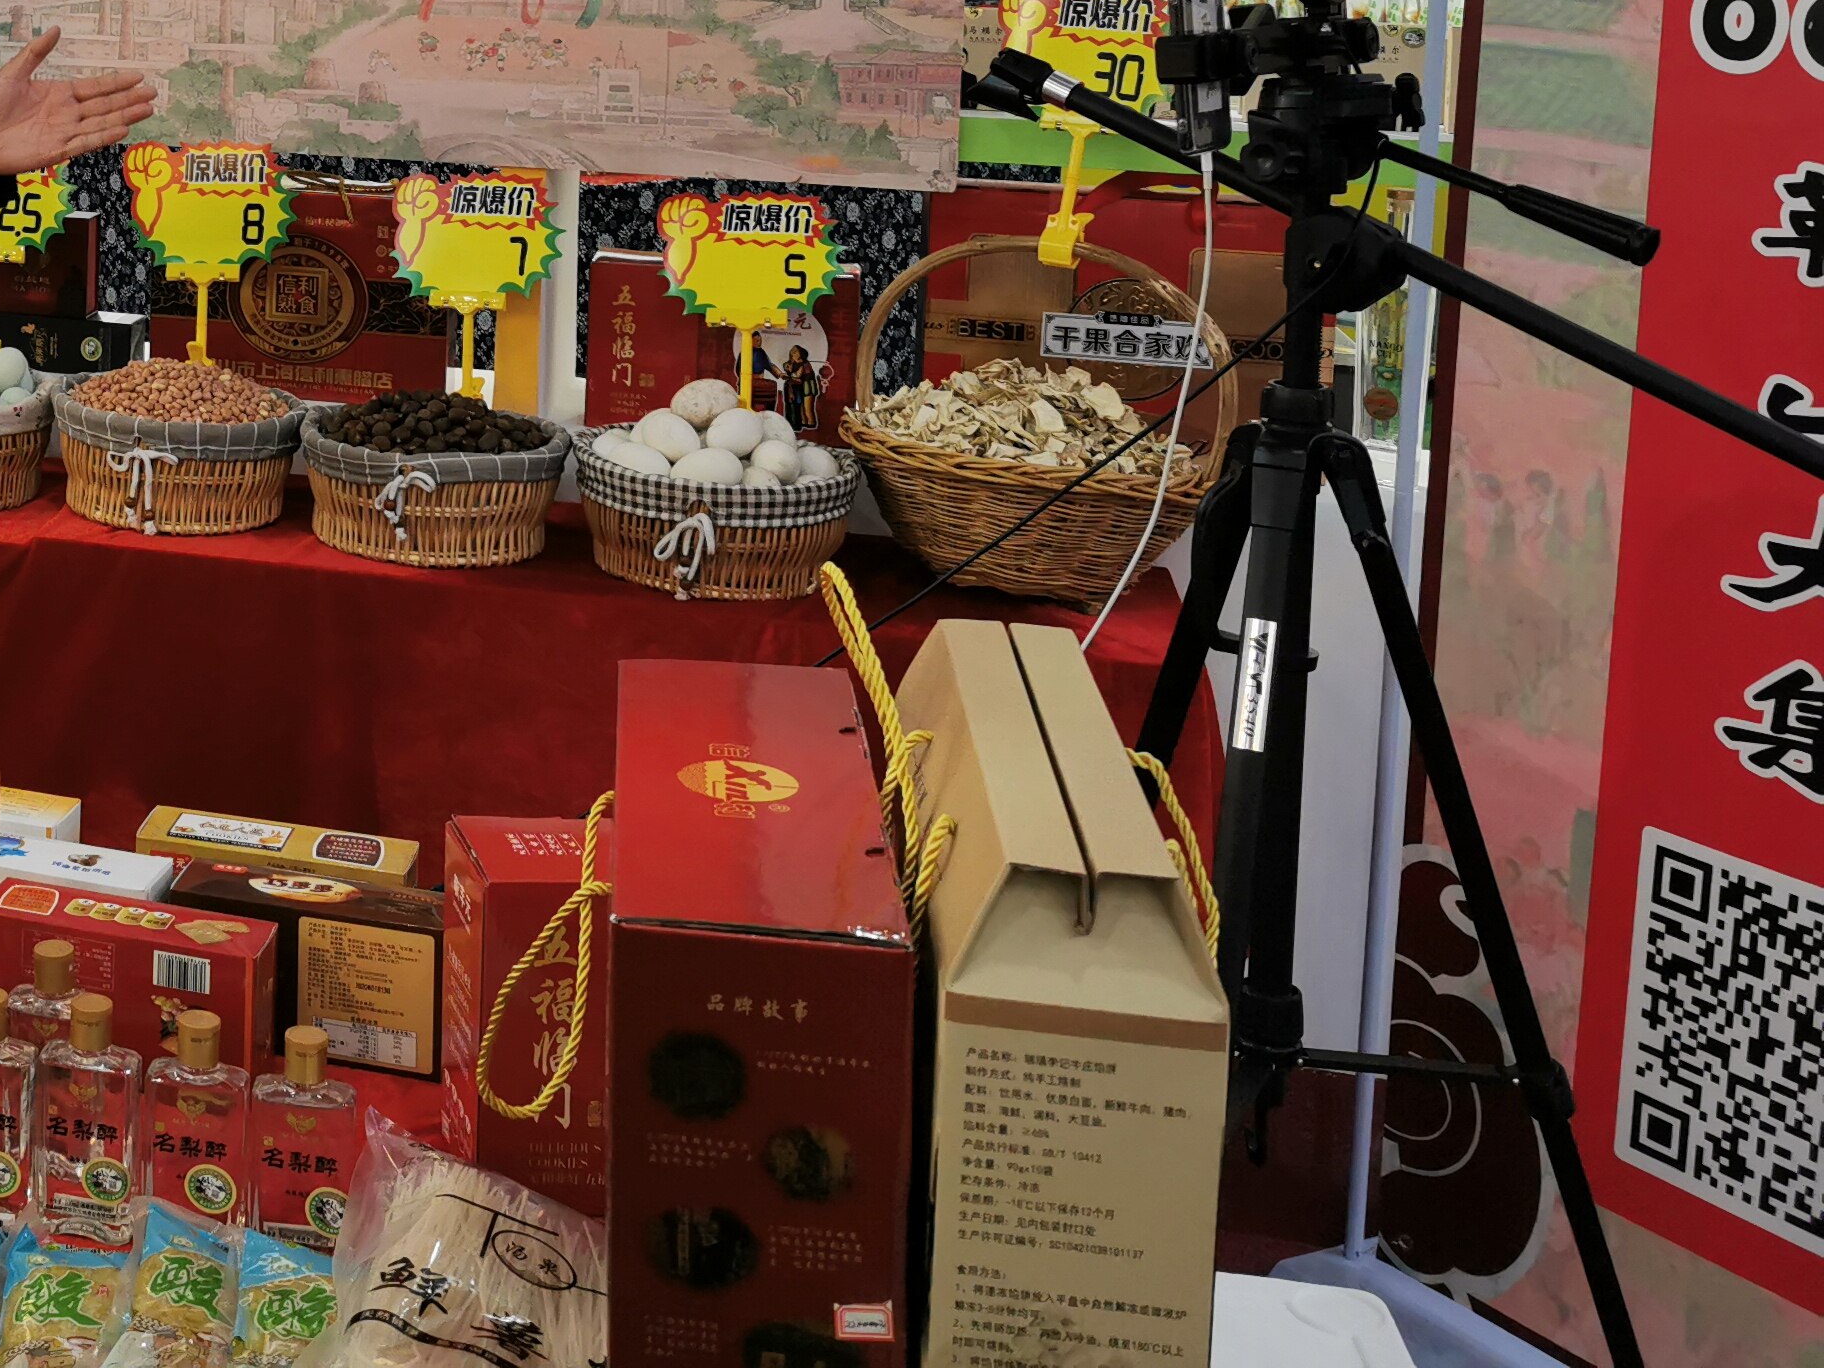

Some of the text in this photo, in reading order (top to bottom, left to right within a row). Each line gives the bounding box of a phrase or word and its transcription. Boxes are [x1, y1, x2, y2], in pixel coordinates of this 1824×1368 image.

[1094, 51, 1144, 102] 30
[184, 153, 267, 183] 惊爆价
[450, 183, 537, 219] 惊爆价
[241, 203, 265, 246] 8
[718, 202, 814, 238] 惊爆价
[509, 236, 528, 276] 7
[279, 275, 317, 295] 信利
[278, 295, 316, 315] 熟食
[611, 285, 637, 388] 五福临门
[956, 319, 1025, 341] BEST
[1051, 325, 1208, 362] 干果合家欢
[706, 993, 811, 1024] 品牌故事
[531, 925, 578, 1130] 五福临门
[46, 1117, 119, 1145] 名梨醉
[153, 1132, 228, 1162] 名梨醉
[262, 1147, 339, 1178] 名梨醉
[13, 1270, 103, 1328] 酸
[147, 1253, 233, 1328] 酸
